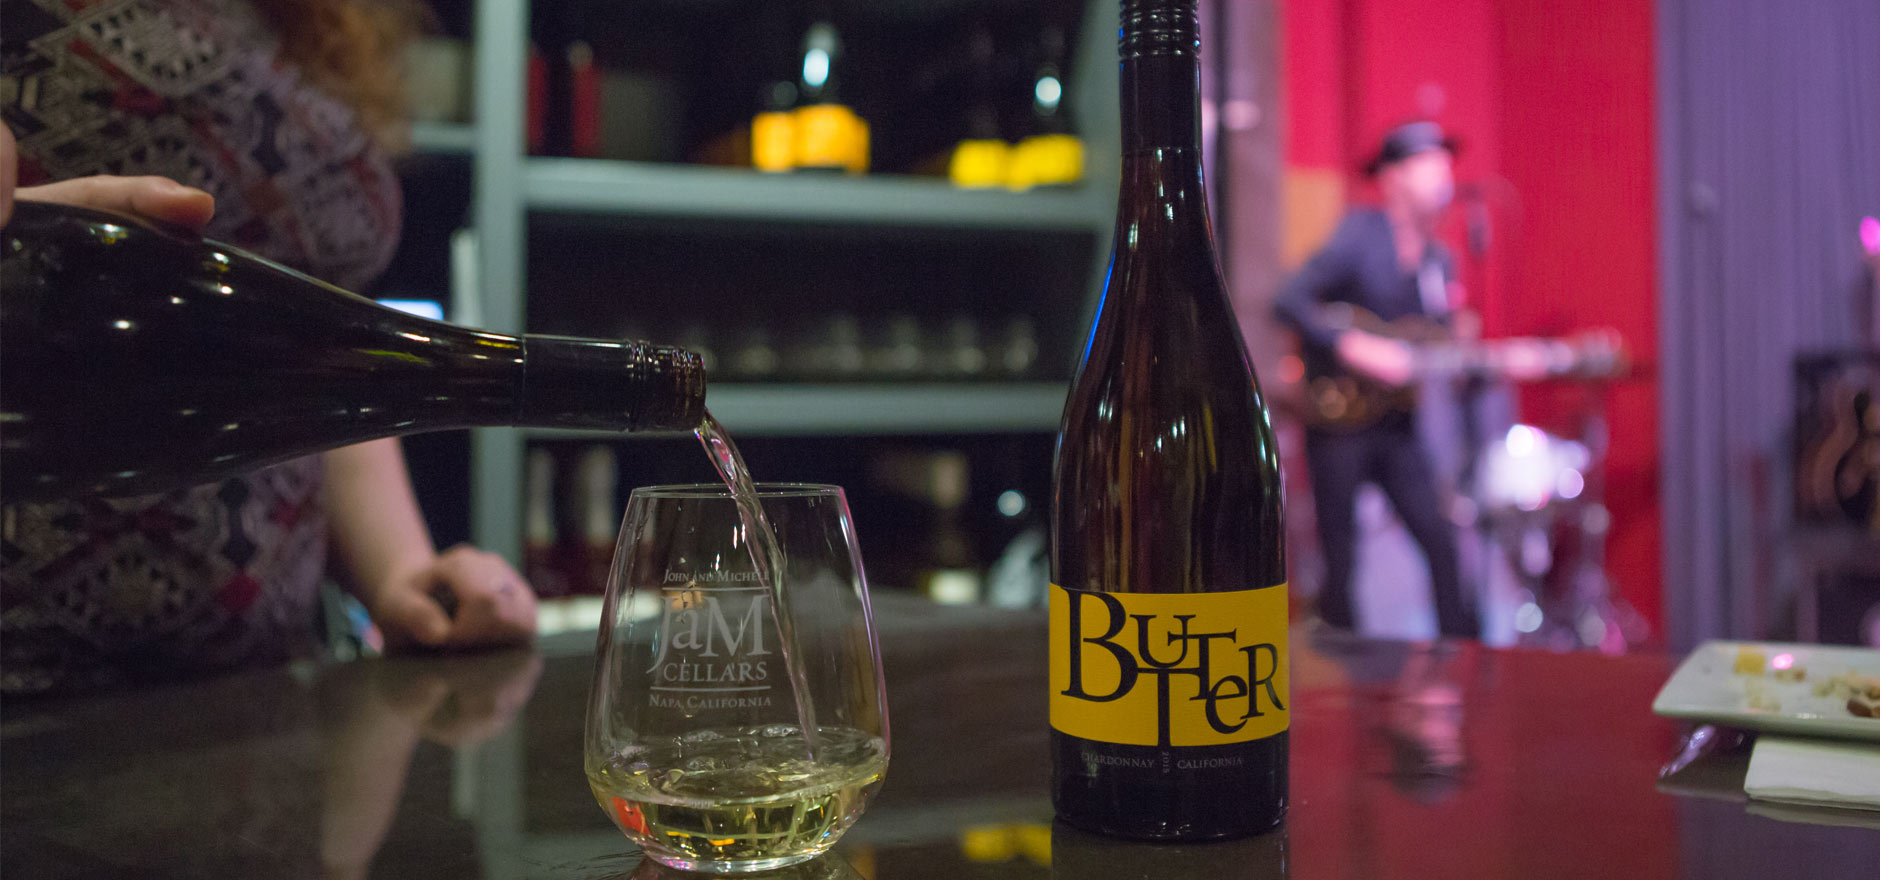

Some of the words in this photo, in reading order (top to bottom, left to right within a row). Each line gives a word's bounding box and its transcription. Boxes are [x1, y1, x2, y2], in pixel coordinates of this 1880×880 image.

[663, 661, 767, 682] CELLARS
[687, 695, 772, 709] CALIFORNIA
[1081, 752, 1155, 769] CHARDONNAY
[1177, 757, 1243, 769] CALIFORNIA
